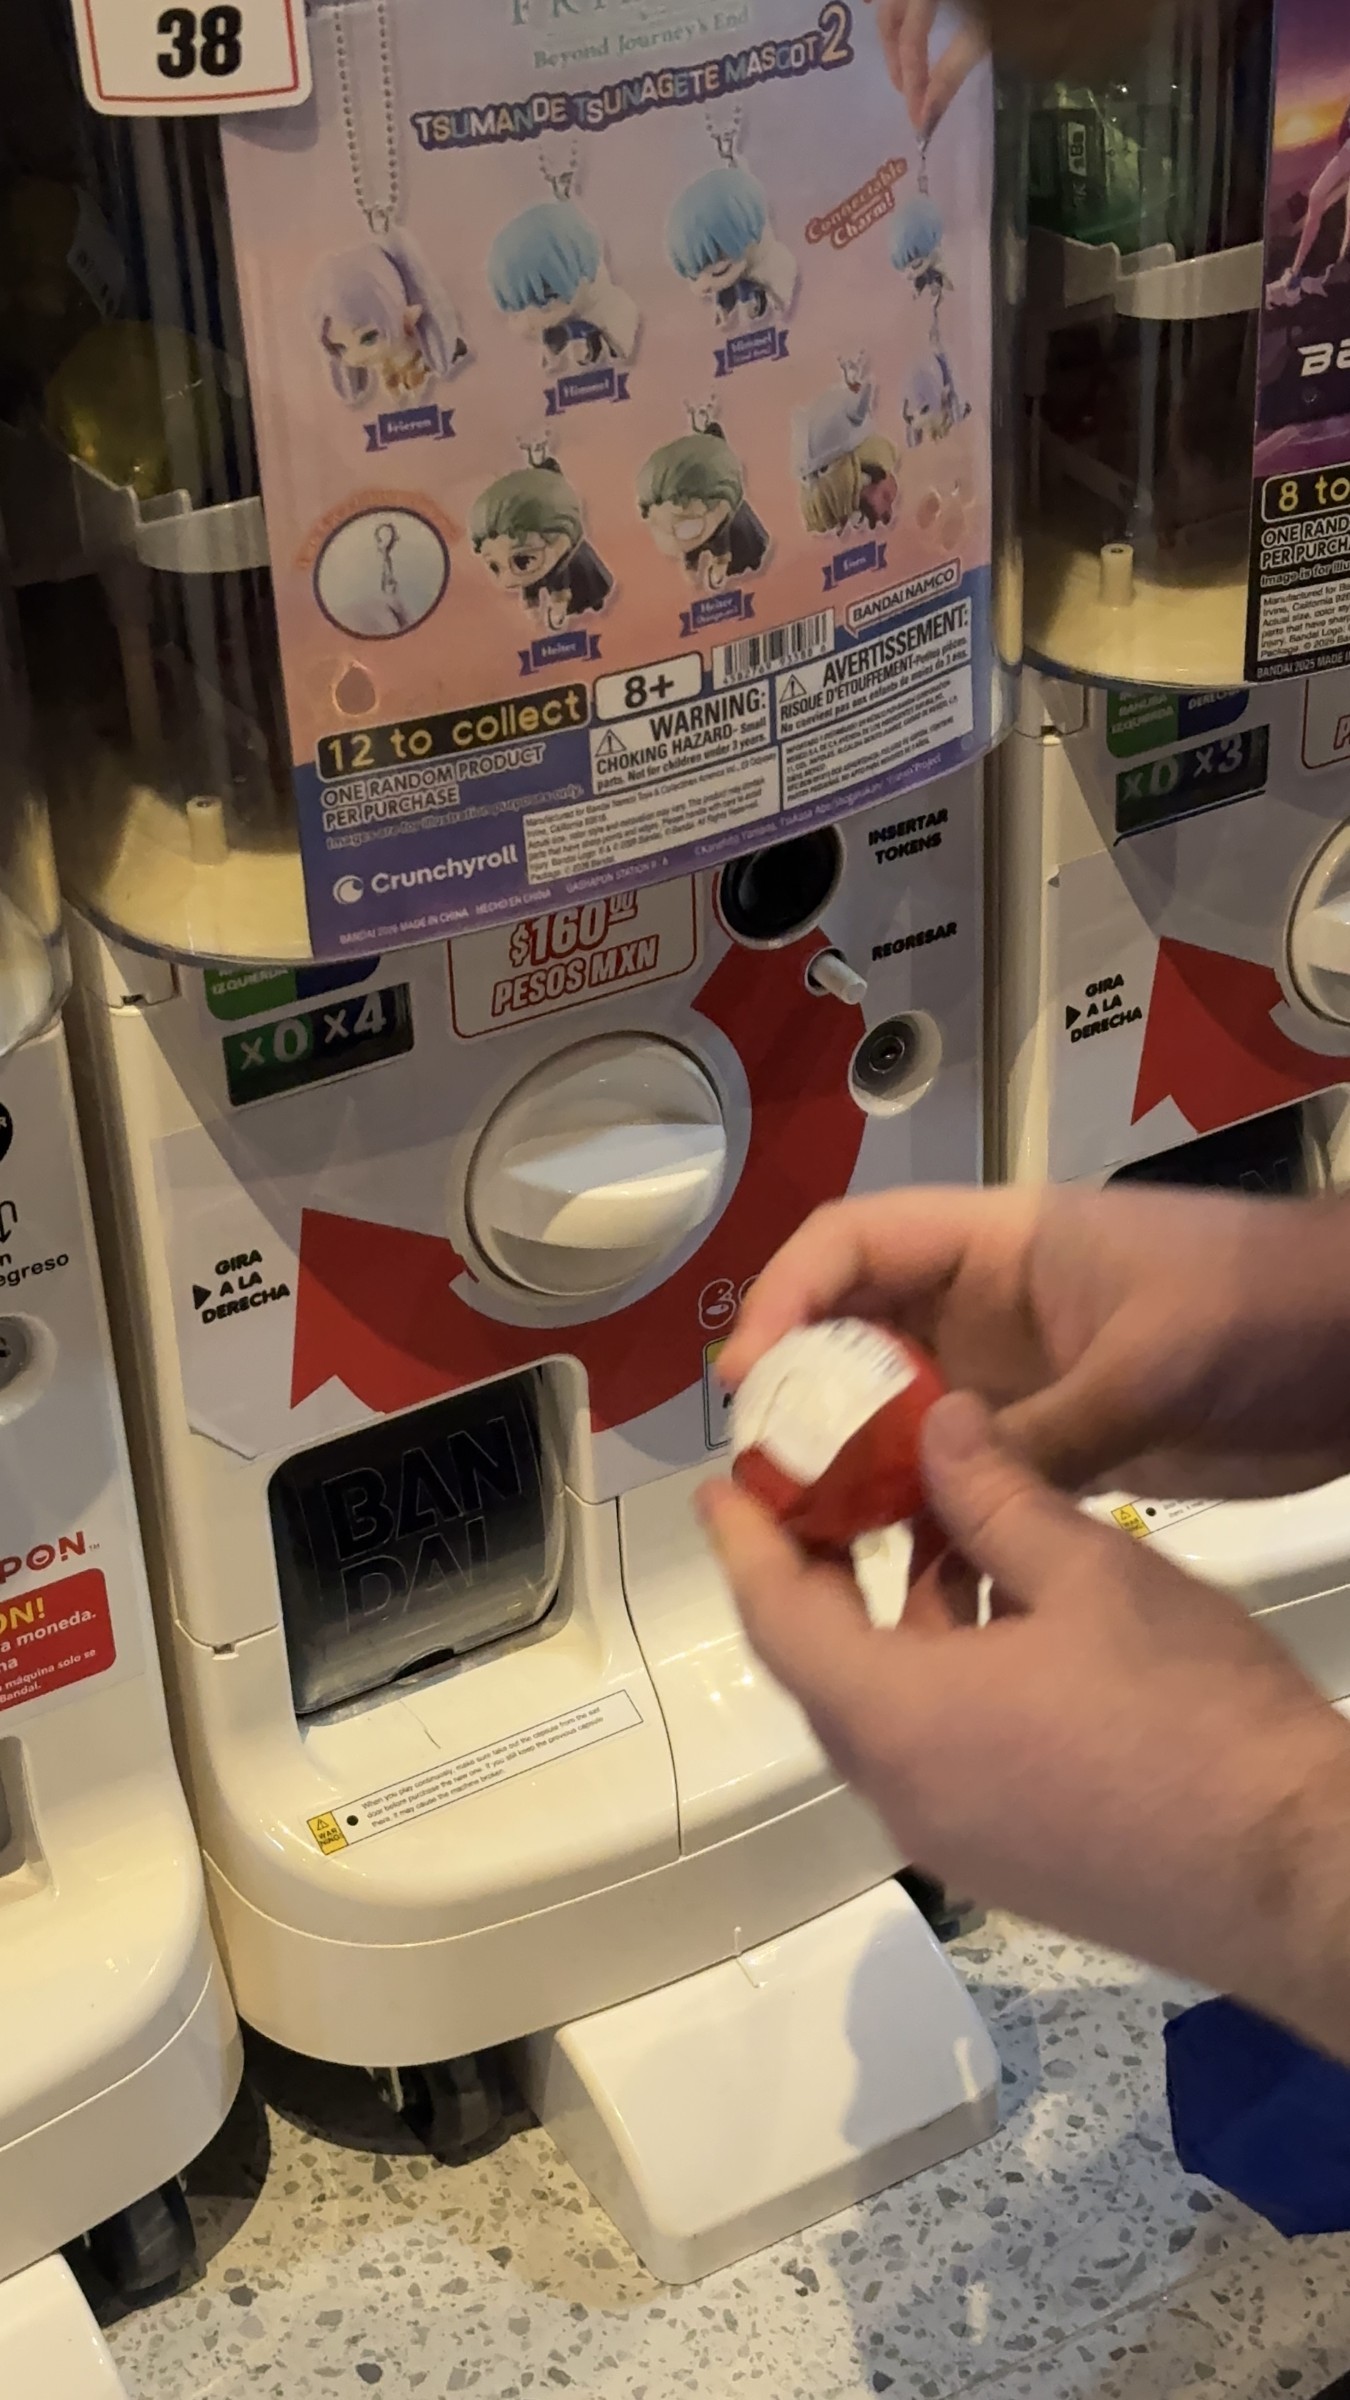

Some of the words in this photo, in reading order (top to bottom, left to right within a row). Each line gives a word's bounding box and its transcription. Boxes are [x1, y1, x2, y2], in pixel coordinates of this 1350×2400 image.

[157, 5, 242, 78] 38
[534, 36, 609, 69] Beyond
[617, 18, 708, 58] Journey's
[713, 5, 750, 31] End
[414, 95, 567, 144] TSUMANDE
[575, 62, 720, 124] TSUNAGETE
[725, 34, 821, 85] MASCOT
[820, 4, 850, 64] 2
[834, 191, 893, 246] Charm!
[1279, 480, 1299, 512] 8
[1315, 475, 1350, 504] to
[1261, 548, 1295, 570] PER
[1296, 536, 1350, 561] PURCH
[1262, 527, 1300, 547] ONE
[1314, 561, 1330, 577] for
[853, 593, 902, 622] BANDAI
[905, 568, 954, 597] NAMCO
[823, 604, 969, 688] AVERTISSEMENT:
[1257, 662, 1294, 679] BANDAI
[1317, 651, 1344, 667] MADE
[624, 674, 675, 709] 8+
[780, 692, 824, 721] RISQUE
[835, 702, 850, 718] pas
[328, 734, 375, 772] 12
[390, 728, 433, 759] to
[452, 690, 582, 746] collect
[650, 688, 766, 741] WARNING:
[596, 743, 667, 776] CHOKING
[741, 716, 766, 735] Small
[597, 775, 624, 792] parts.
[628, 767, 646, 782] Not
[648, 763, 661, 779] for
[663, 752, 701, 773] children
[703, 743, 730, 761] under
[740, 733, 766, 751] years.
[323, 785, 363, 807] ONE
[370, 766, 454, 795] RANDOM
[458, 745, 546, 779] PRODUCT
[324, 810, 360, 831] PER
[364, 787, 459, 820] PURCHASE
[868, 808, 948, 846] INSERTAR
[875, 832, 942, 864] TOKENS
[371, 846, 518, 895] Crunchyroll
[400, 917, 426, 933] MADE
[438, 907, 469, 924] CHINA
[872, 921, 957, 961] REGRESAR
[491, 956, 587, 1017] PESOS
[588, 933, 660, 988] MXN
[1085, 973, 1124, 998] GIRA
[1071, 1006, 1143, 1043] DERECHA
[1086, 1001, 1100, 1018] A
[1102, 994, 1122, 1012] LA
[215, 1249, 262, 1275] GIRA
[202, 1282, 290, 1324] DERECHA
[219, 1281, 234, 1297] A
[238, 1271, 262, 1290] LA
[322, 1416, 522, 1562] BAN
[340, 1516, 490, 1635] DAI
[16, 1608, 97, 1647] moneda.
[5, 1663, 55, 1690] máquina
[57, 1654, 82, 1670] solo
[83, 1648, 96, 1660] se
[362, 1797, 384, 1810] When
[384, 1792, 398, 1802] you
[456, 1759, 475, 1771] make
[476, 1753, 491, 1763] sure
[520, 1736, 532, 1744] the
[559, 1717, 576, 1727] from
[576, 1713, 588, 1721] the
[408, 1785, 440, 1803] purchase
[440, 1780, 453, 1788] the
[535, 1740, 548, 1749] the
[450, 1779, 480, 1795] machine
